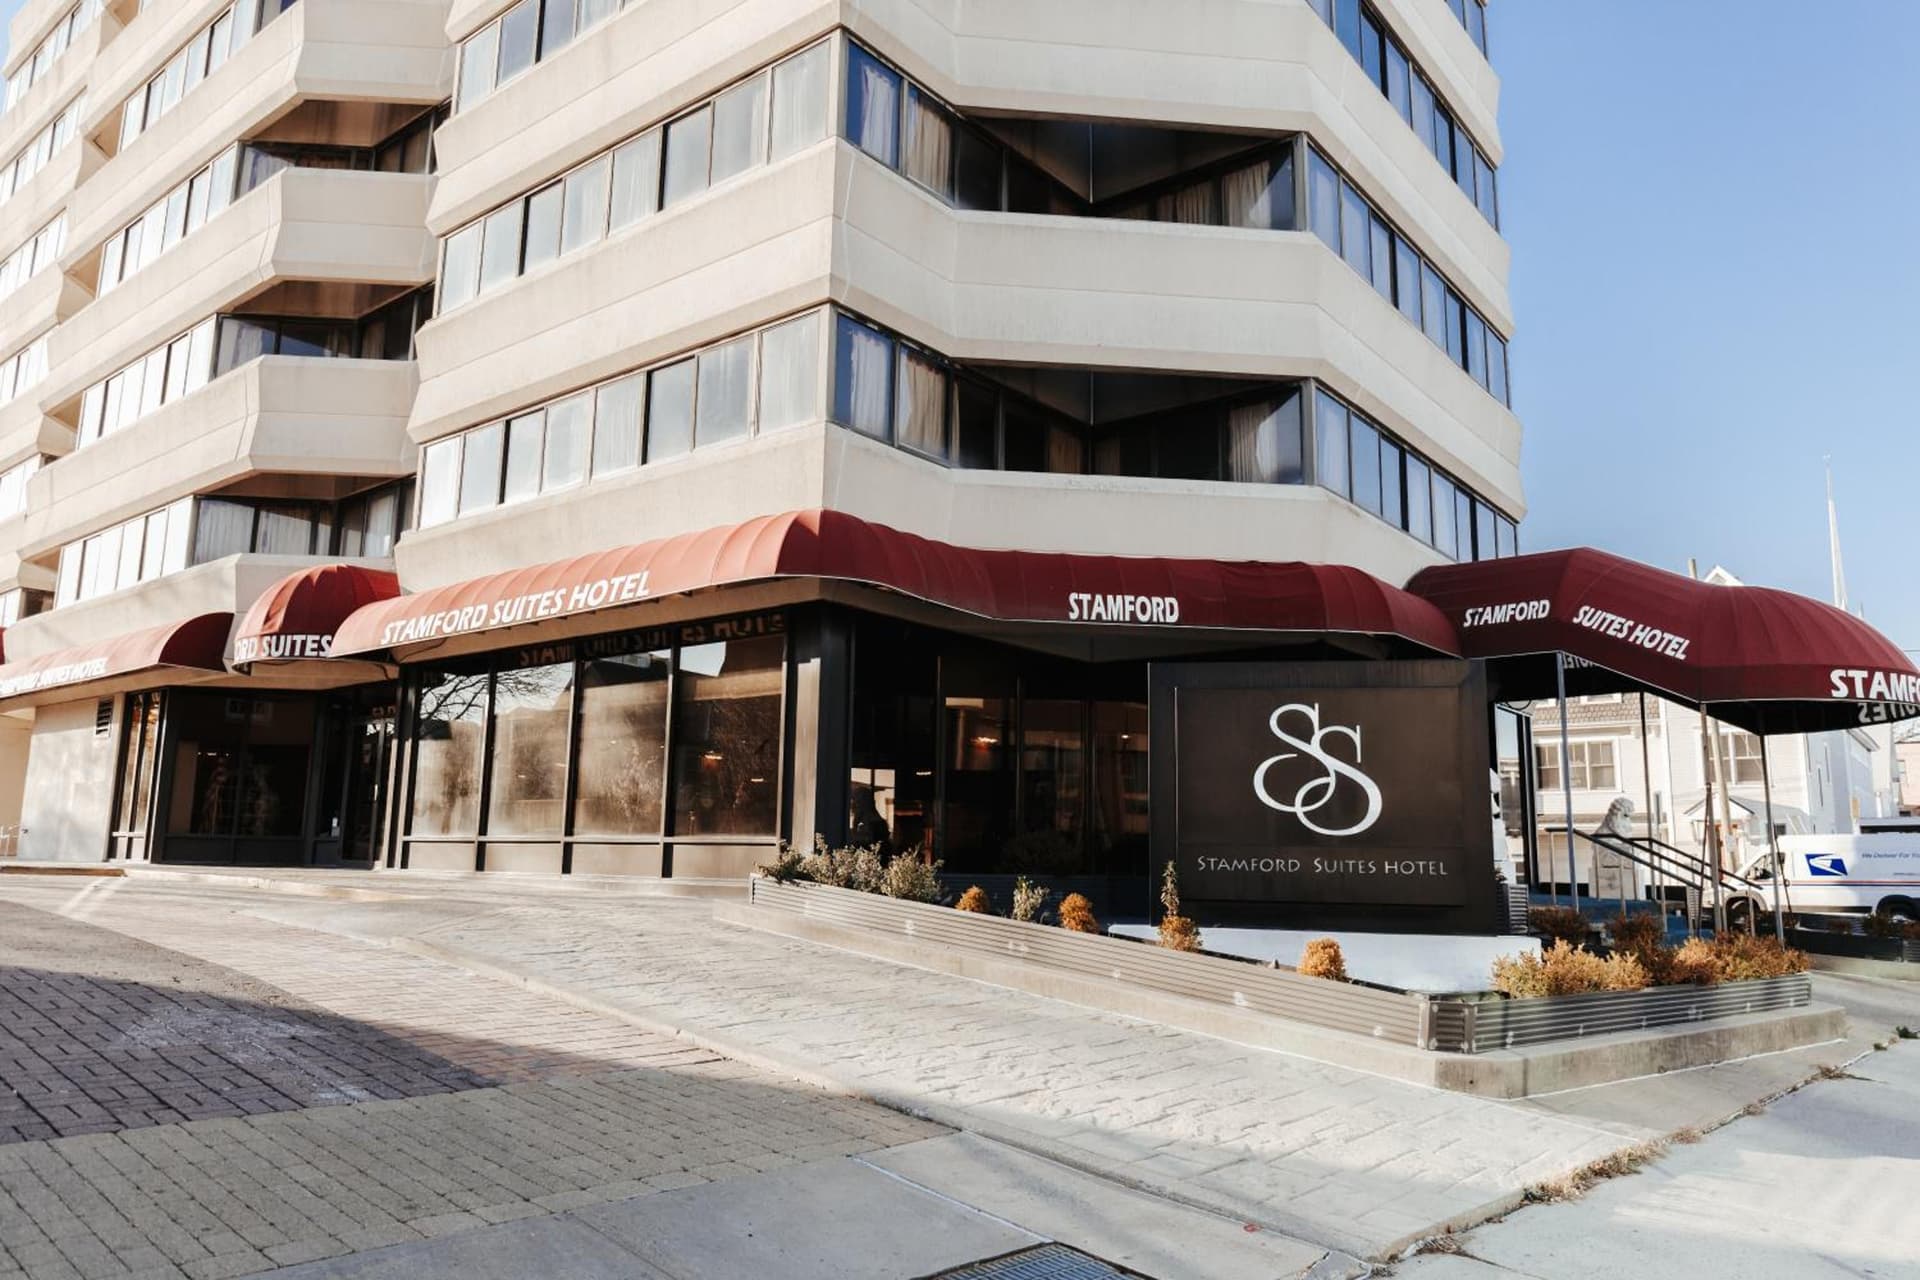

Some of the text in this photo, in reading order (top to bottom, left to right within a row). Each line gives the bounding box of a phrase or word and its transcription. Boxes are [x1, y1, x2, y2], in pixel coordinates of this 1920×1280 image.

[381, 570, 651, 645] STAMFORD SUITES HOTEL
[1068, 592, 1180, 623] STAMFORD
[262, 634, 333, 657] SUITES
[1463, 599, 1691, 660] STAMFORD SUITES HOTEL
[1829, 668, 1920, 703] STAMF
[1197, 856, 1449, 876] STAMFORD SUITES HOTEL
